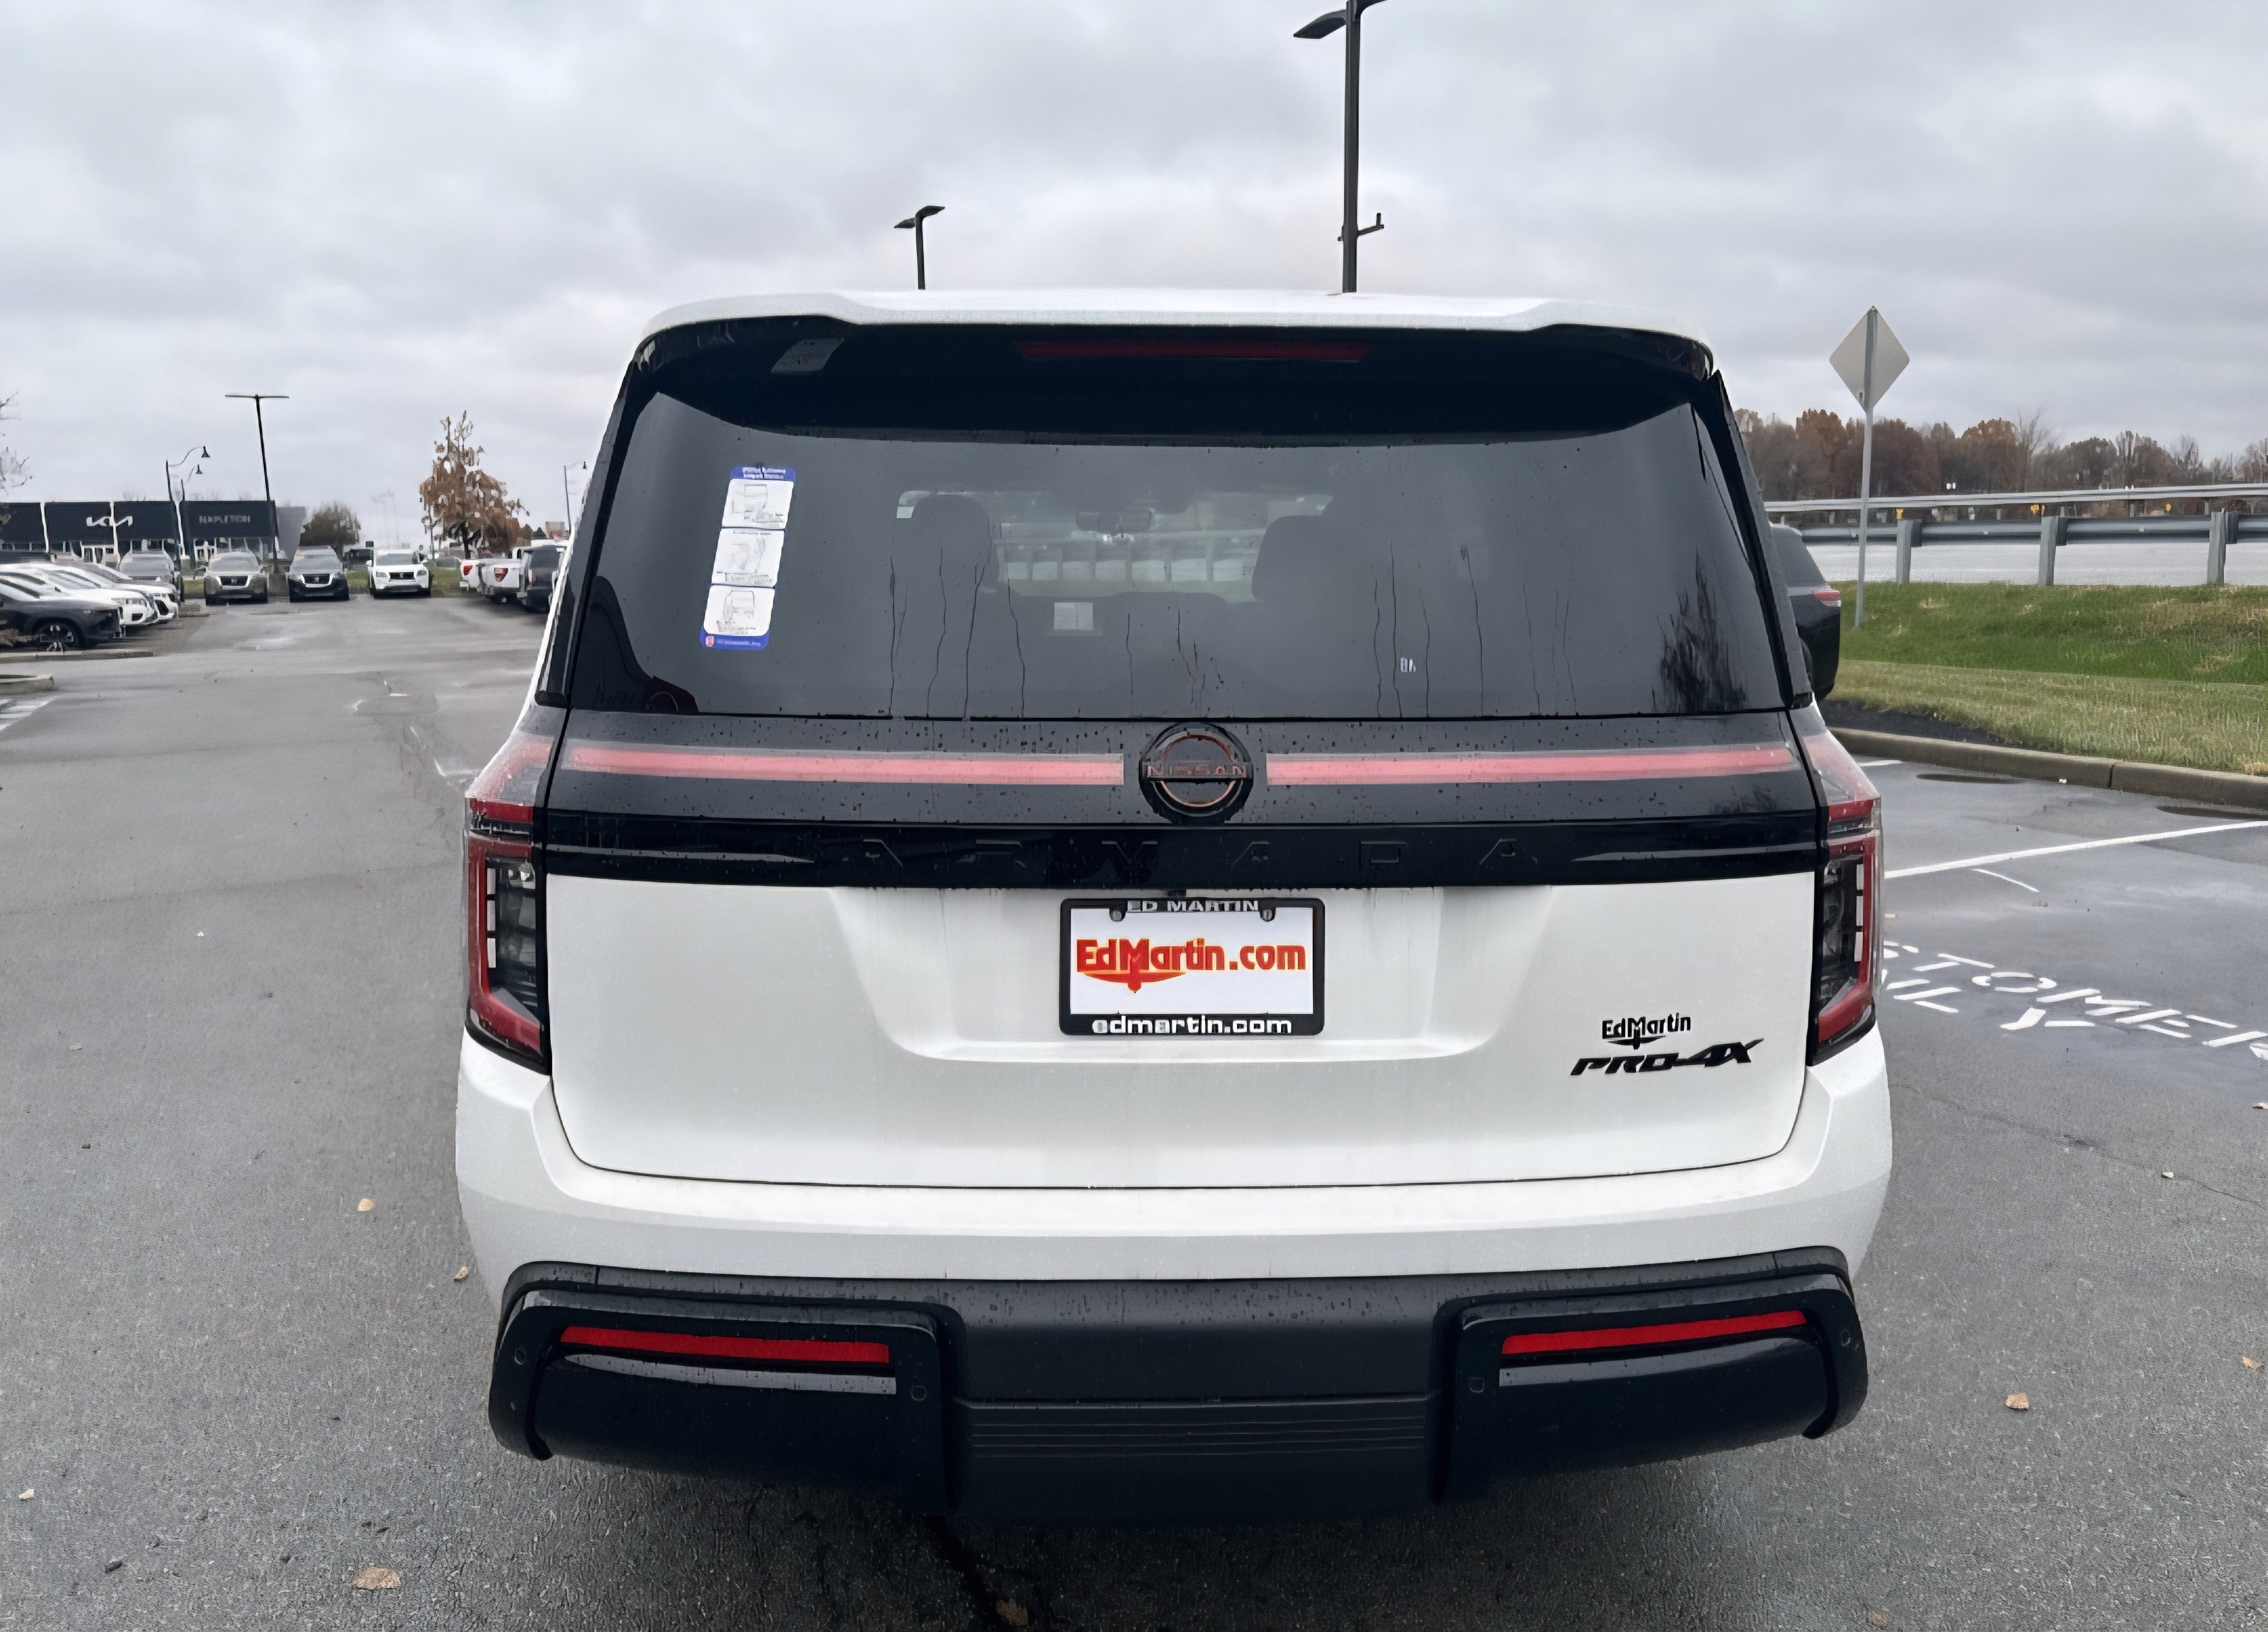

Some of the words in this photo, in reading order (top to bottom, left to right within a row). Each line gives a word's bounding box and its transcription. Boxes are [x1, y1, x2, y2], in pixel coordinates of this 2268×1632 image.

[1147, 763, 1247, 779] NISSAN
[1167, 899, 1258, 912] MARTIN
[1076, 938, 1306, 972] EdMartin.com
[1091, 1015, 1292, 1034] edmartin.com
[1601, 1012, 1692, 1039] EdMartin
[1570, 1038, 1764, 1076] PRO-4X
